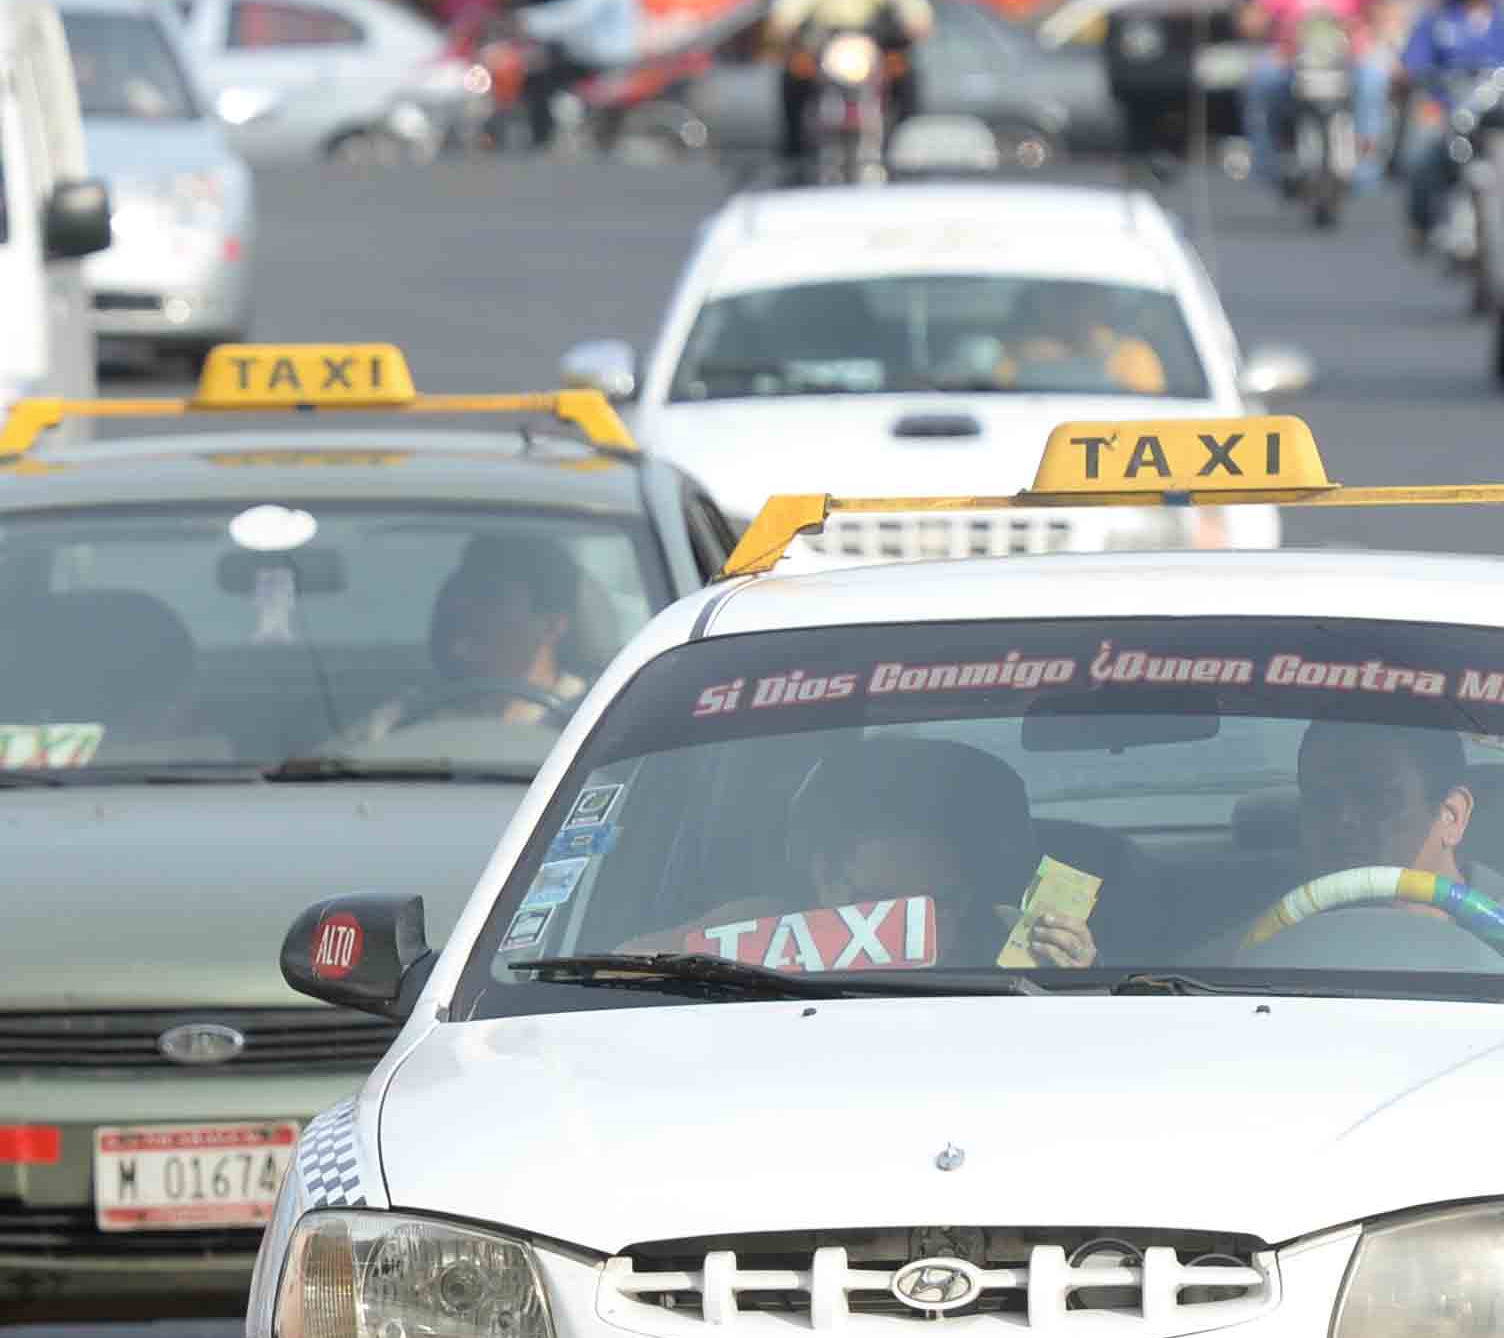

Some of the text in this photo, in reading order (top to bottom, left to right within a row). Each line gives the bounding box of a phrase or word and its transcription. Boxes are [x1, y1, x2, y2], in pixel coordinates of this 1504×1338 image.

[230, 356, 382, 390] TAXI
[1069, 432, 1281, 480] TAXI
[693, 678, 745, 717] Si
[753, 669, 857, 709] Dios
[866, 650, 1077, 694] Conmigo
[1265, 654, 1448, 695] Contra
[316, 924, 356, 970] ALTO
[703, 894, 927, 973] TAXI
[118, 1153, 277, 1200] M 01674
